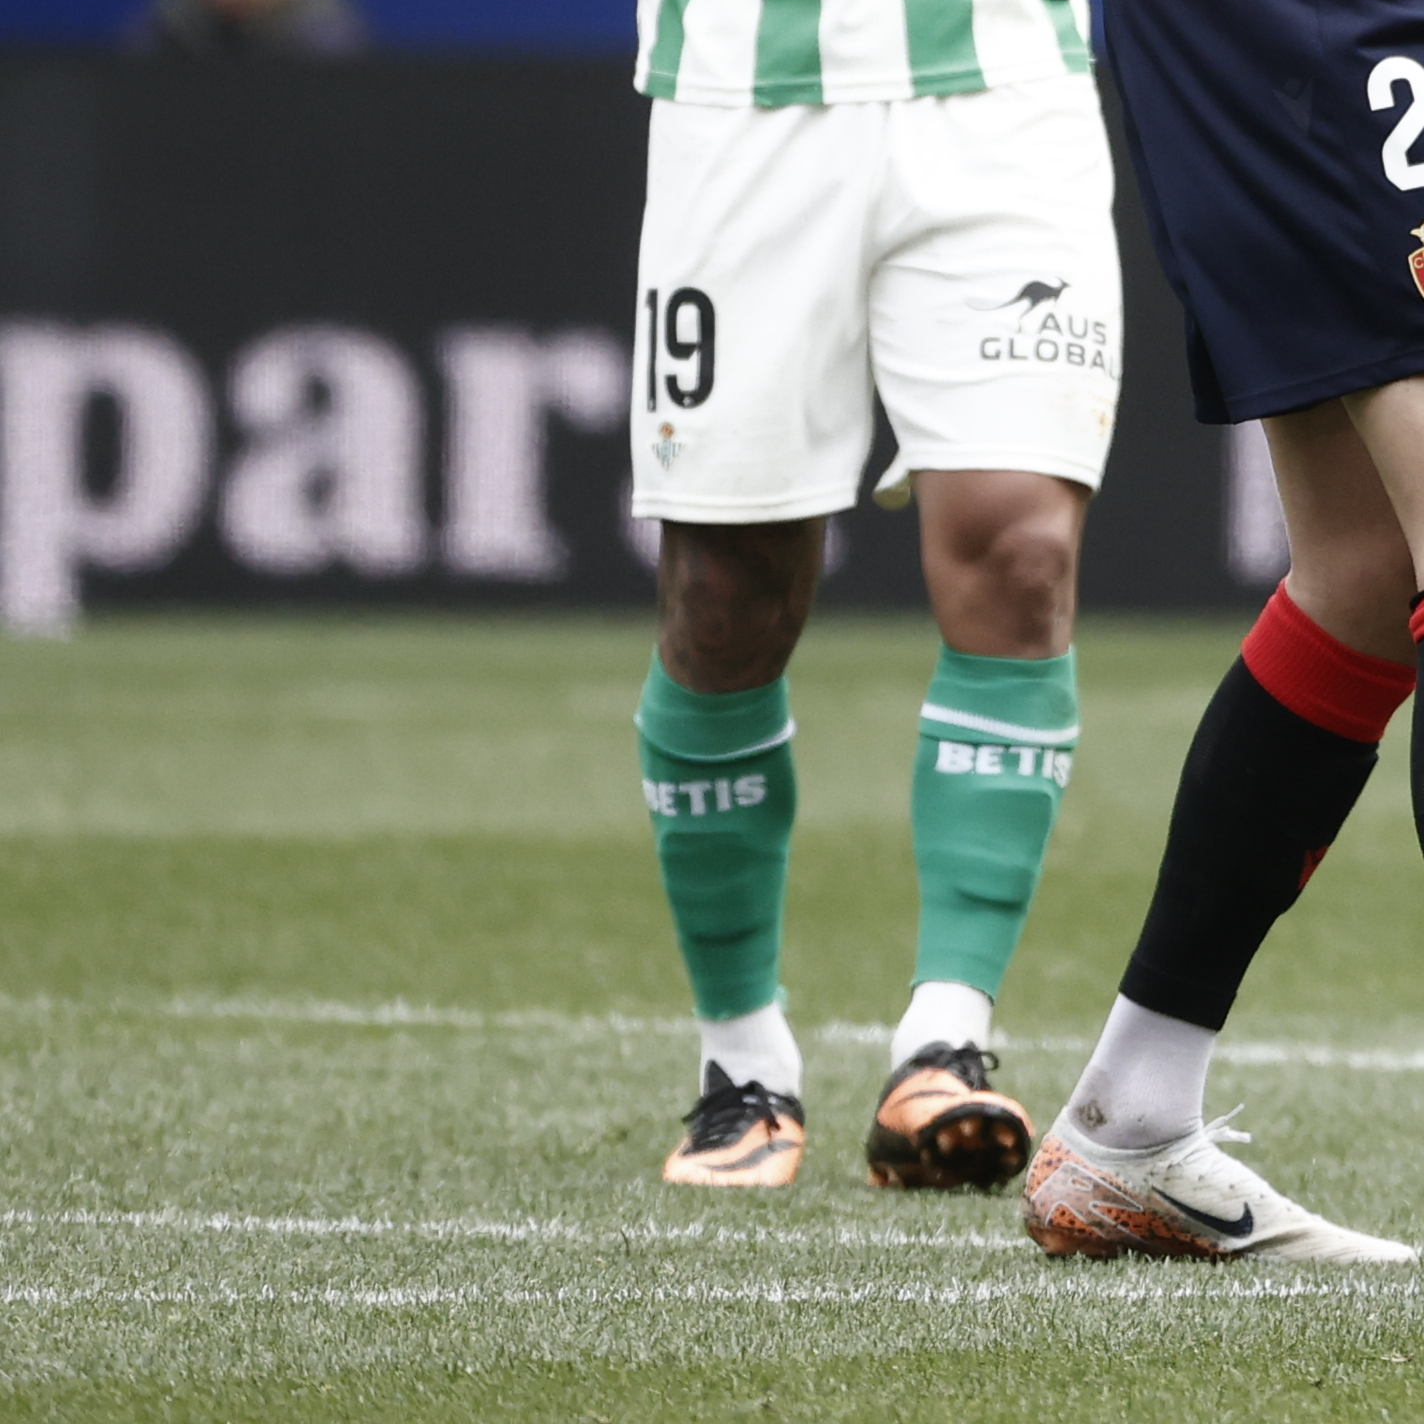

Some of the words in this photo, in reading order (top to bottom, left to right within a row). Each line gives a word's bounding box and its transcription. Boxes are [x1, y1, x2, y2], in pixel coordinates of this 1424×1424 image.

[645, 286, 716, 413] 19
[1036, 310, 1108, 346] AUS
[979, 335, 1121, 382] GLOBAL
[934, 739, 1073, 789] BETIS
